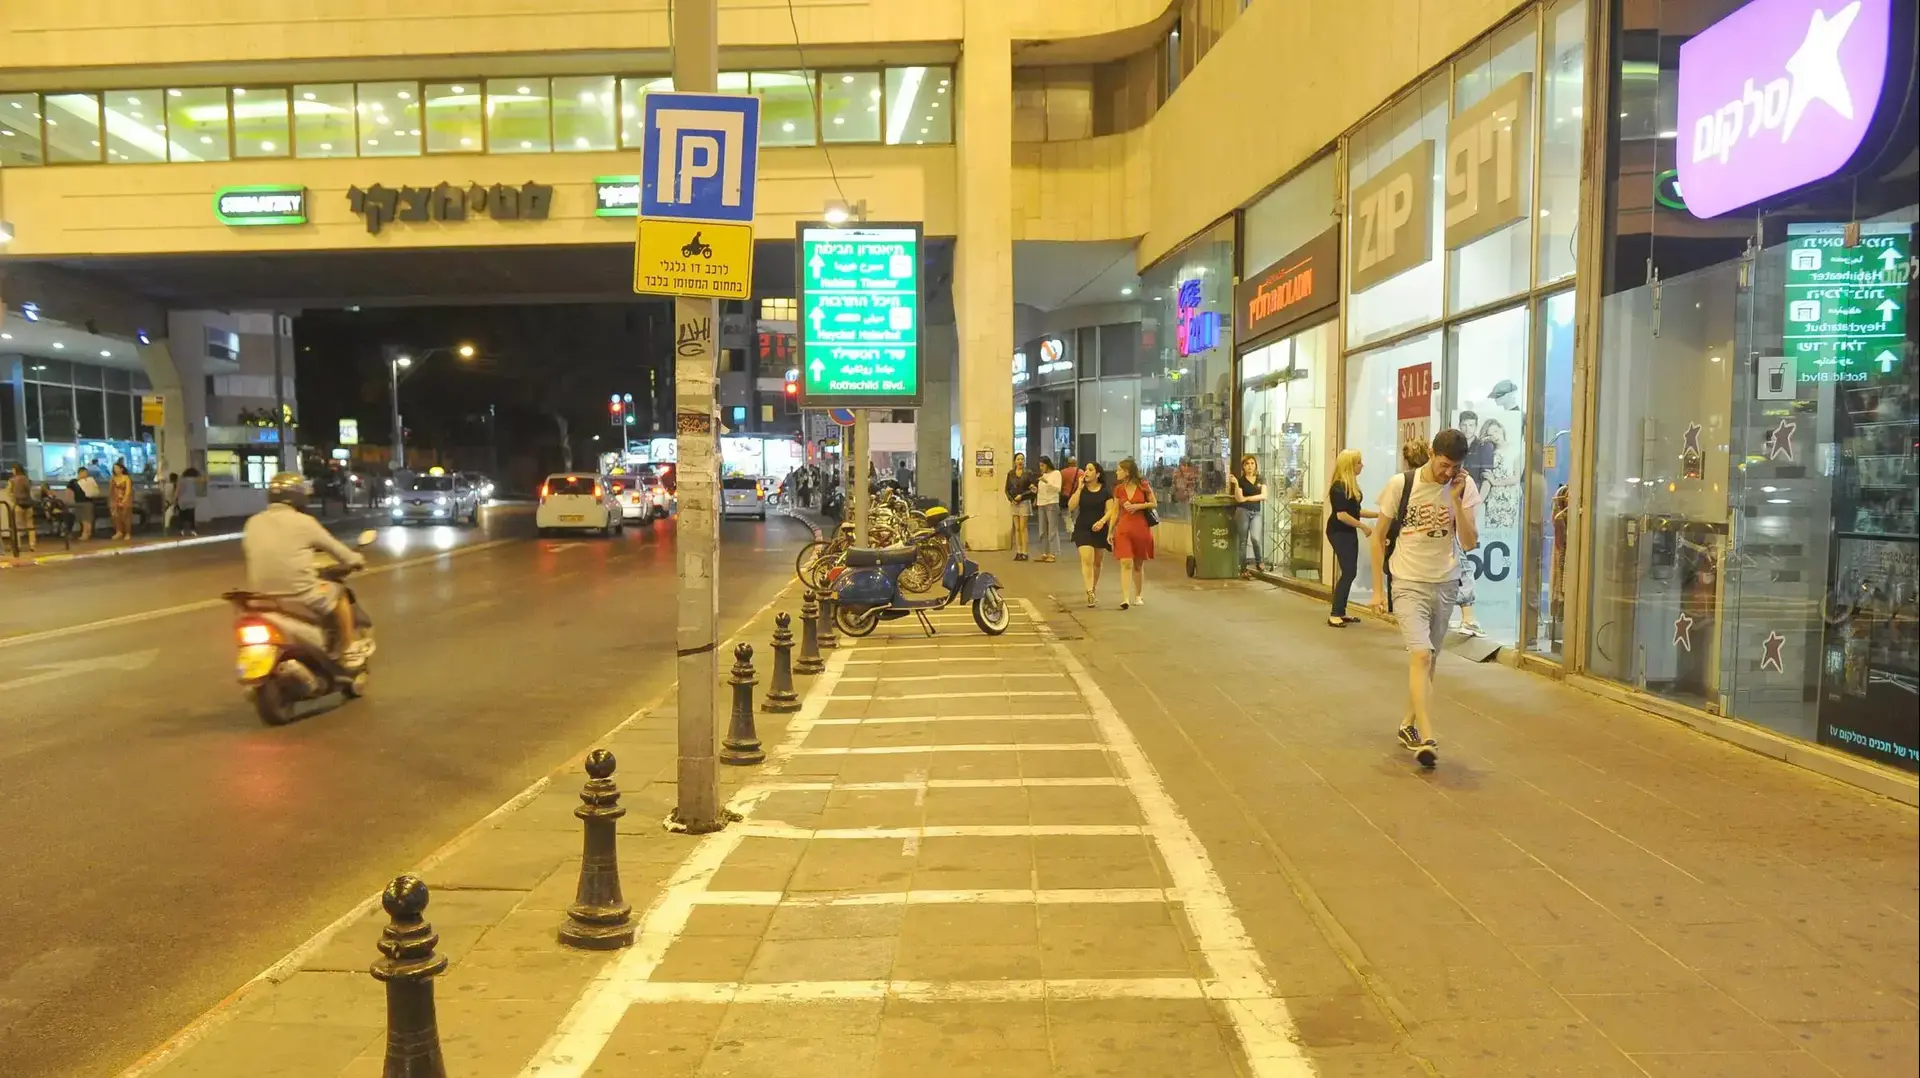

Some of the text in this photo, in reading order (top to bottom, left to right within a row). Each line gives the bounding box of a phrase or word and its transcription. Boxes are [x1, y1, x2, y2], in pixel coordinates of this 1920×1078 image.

[1692, 77, 1790, 164] סלקום
[1358, 172, 1413, 273] ZIP
[660, 260, 729, 276] לרכב דו גלגלי
[645, 275, 742, 292] בתחום המסומן בלבד
[829, 380, 906, 390] Rothschild Blvd.
[1402, 370, 1428, 399] SALE
[1839, 728, 1867, 746] בסלקום
[1868, 738, 1891, 753] תכנים
[1893, 742, 1906, 757] של
